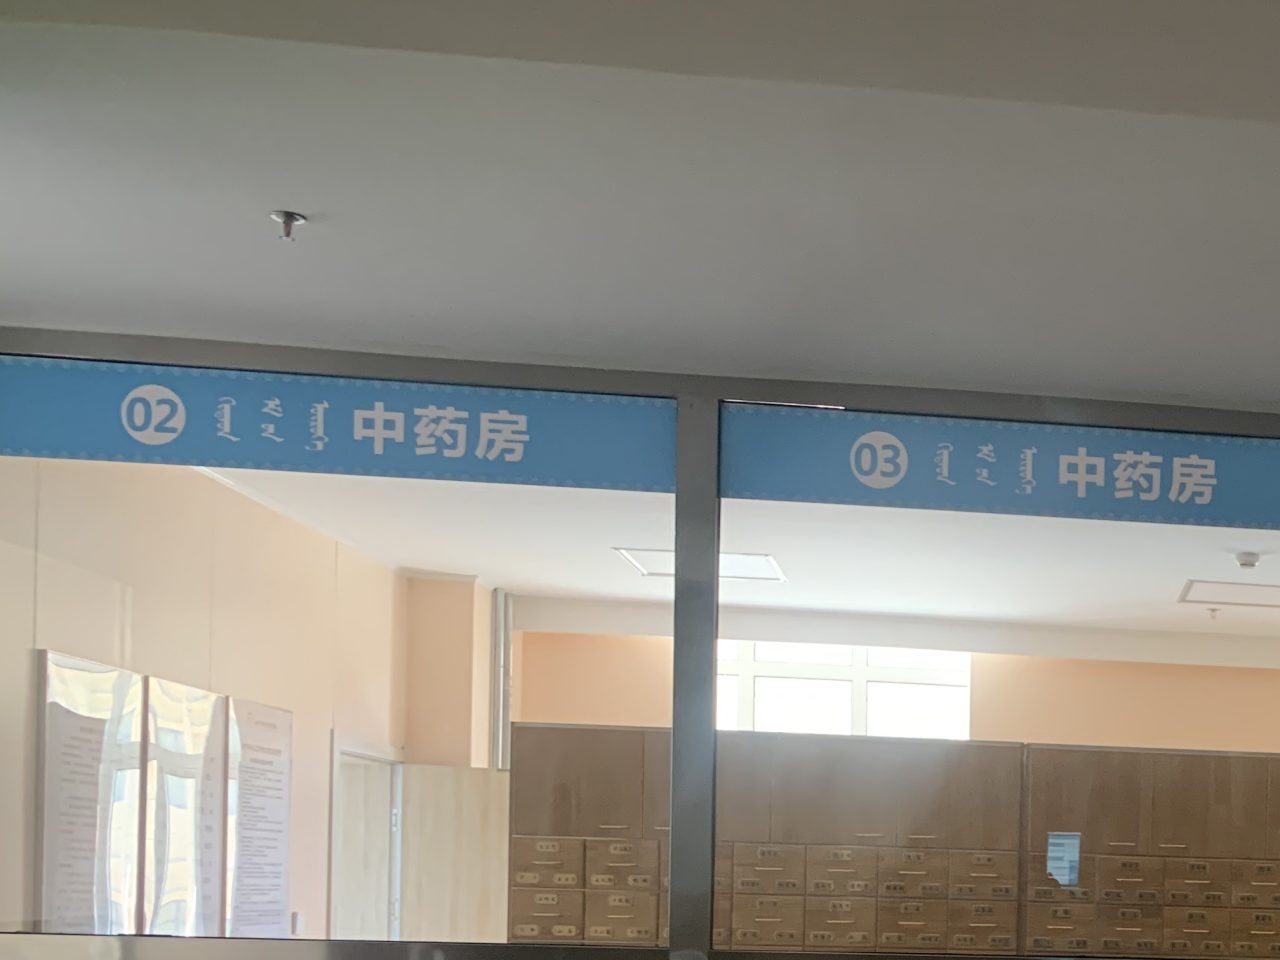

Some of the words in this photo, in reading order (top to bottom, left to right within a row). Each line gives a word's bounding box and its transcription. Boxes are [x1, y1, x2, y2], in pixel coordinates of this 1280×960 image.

[127, 397, 178, 434] 02
[353, 402, 529, 463] 中药房
[855, 442, 901, 478] 03
[1059, 447, 1217, 505] 中药房
